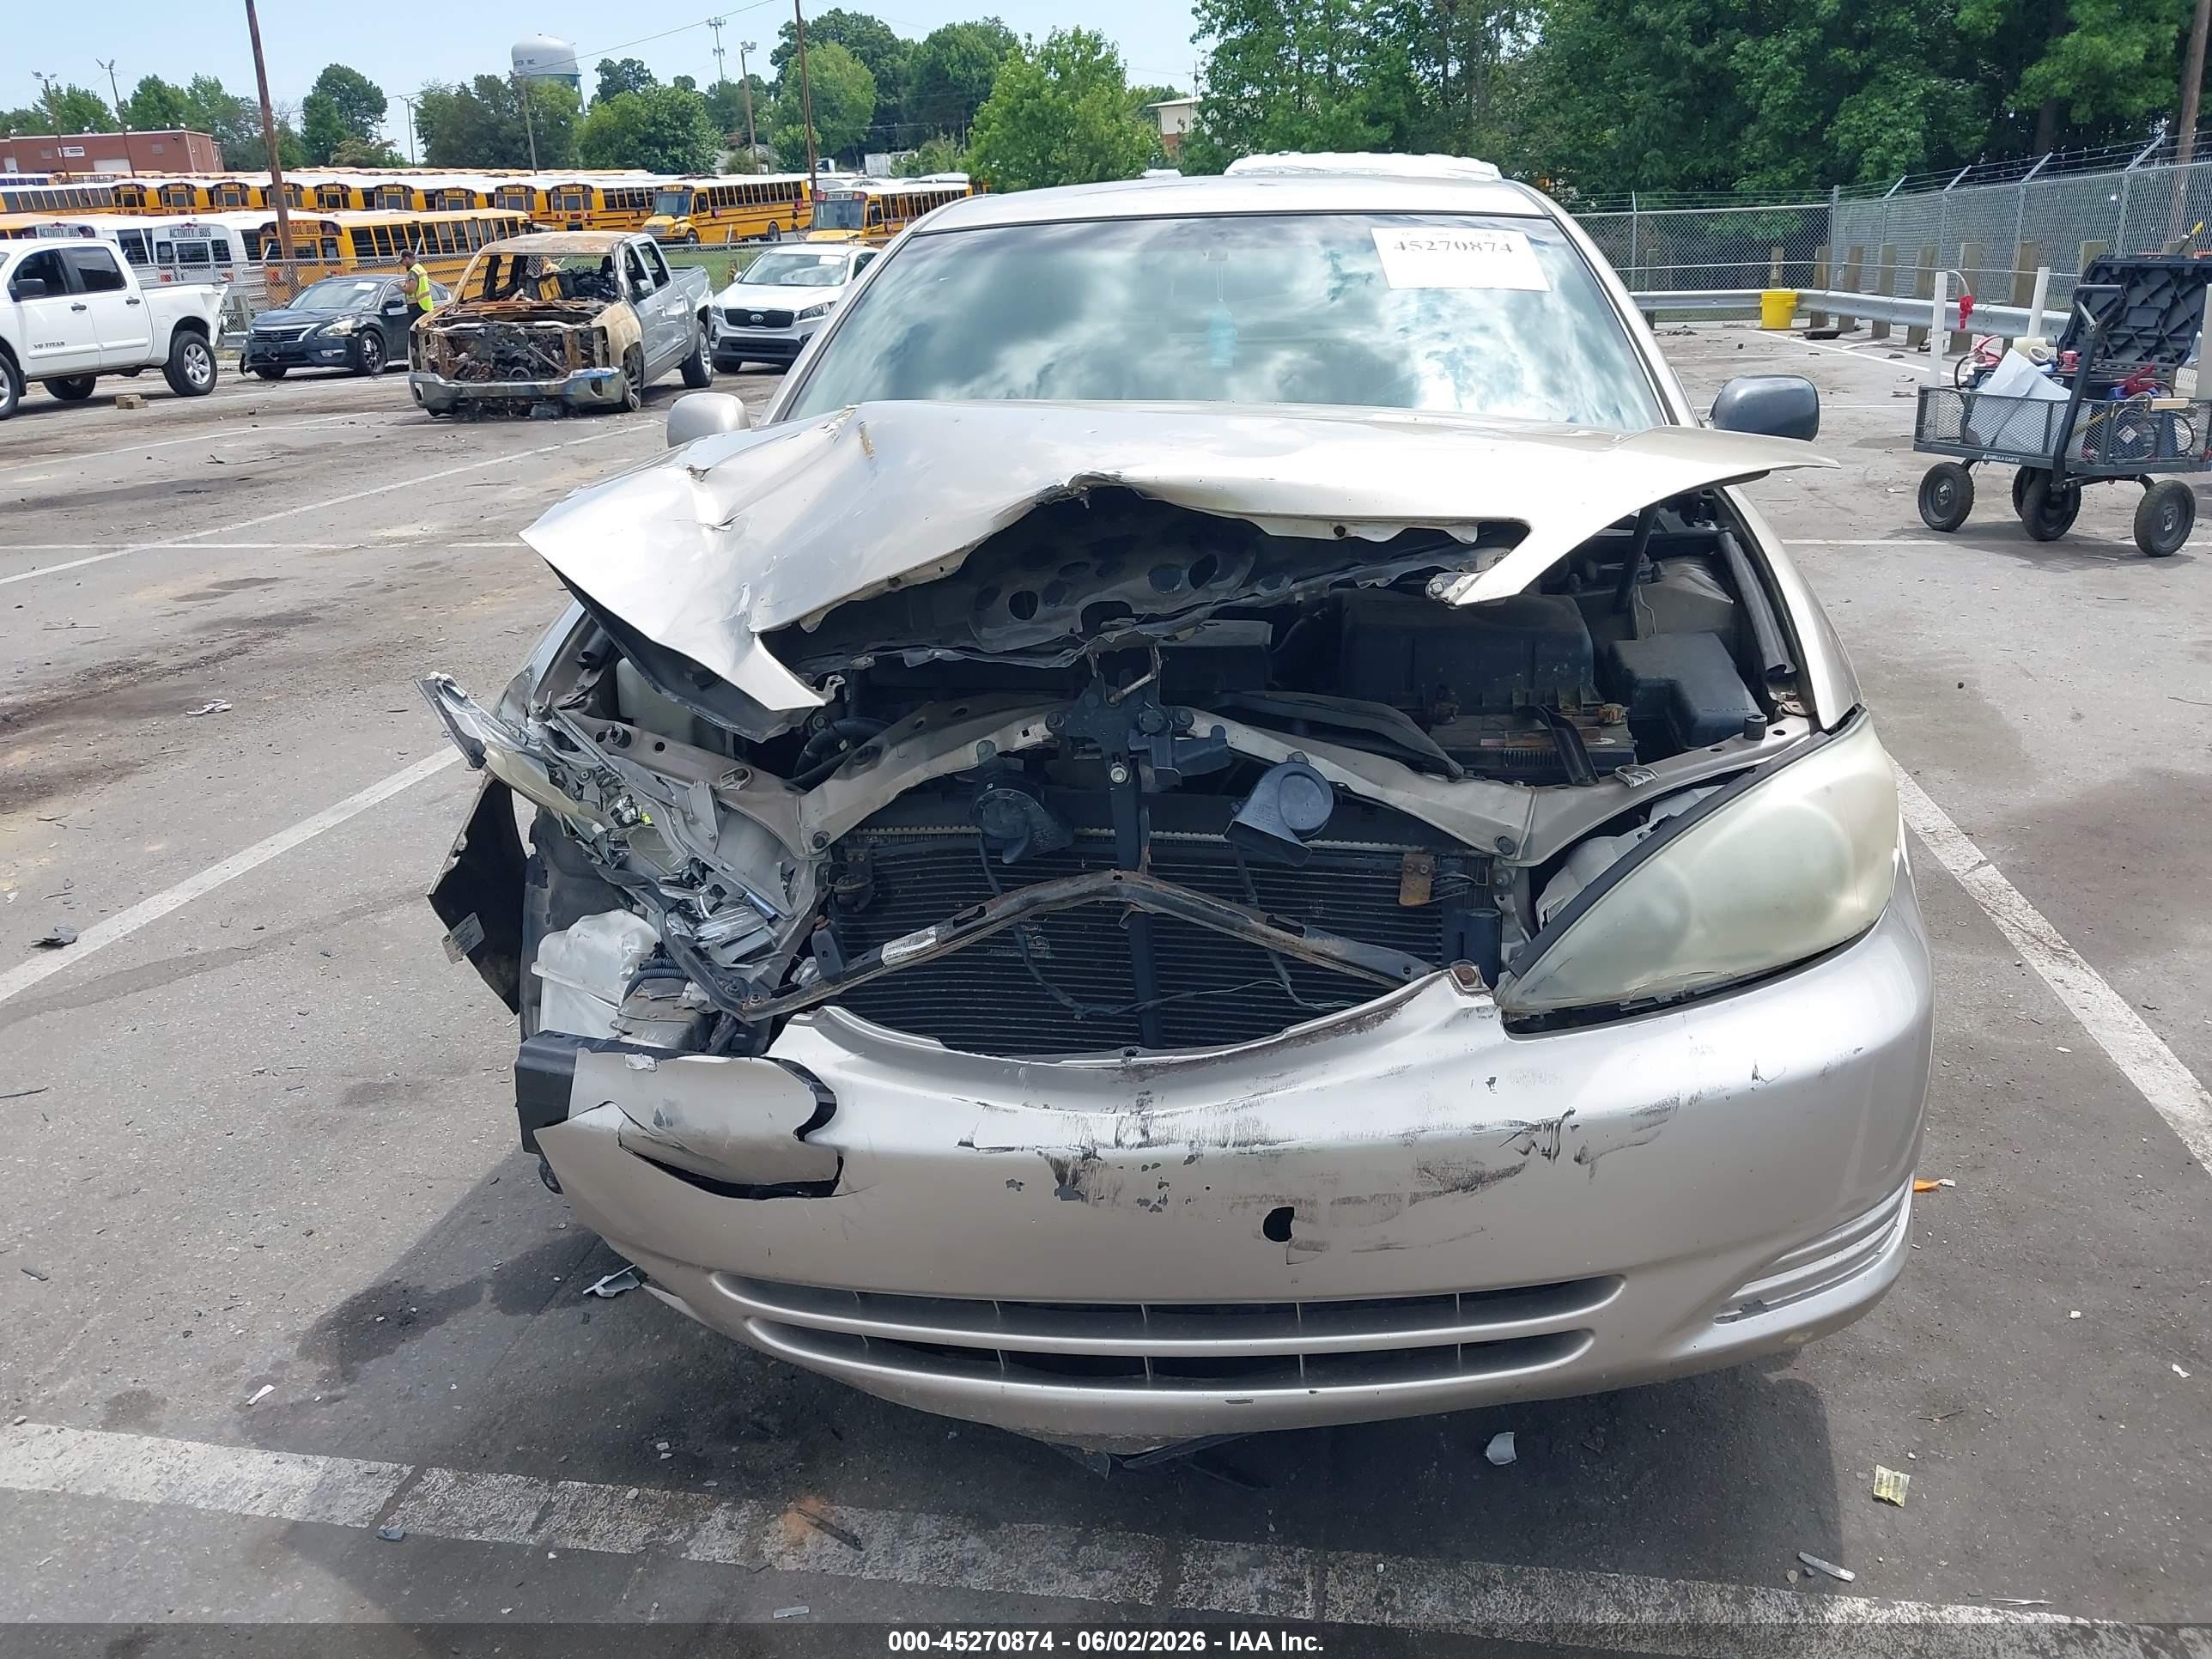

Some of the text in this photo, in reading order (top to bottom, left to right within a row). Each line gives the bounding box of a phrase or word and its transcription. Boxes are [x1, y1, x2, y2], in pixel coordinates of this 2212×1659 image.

[40, 228, 81, 238] ACTIVITY BUS
[169, 228, 211, 238] ACTIVITY BUS
[307, 225, 319, 234] BUS
[1395, 240, 1513, 252] 45270874
